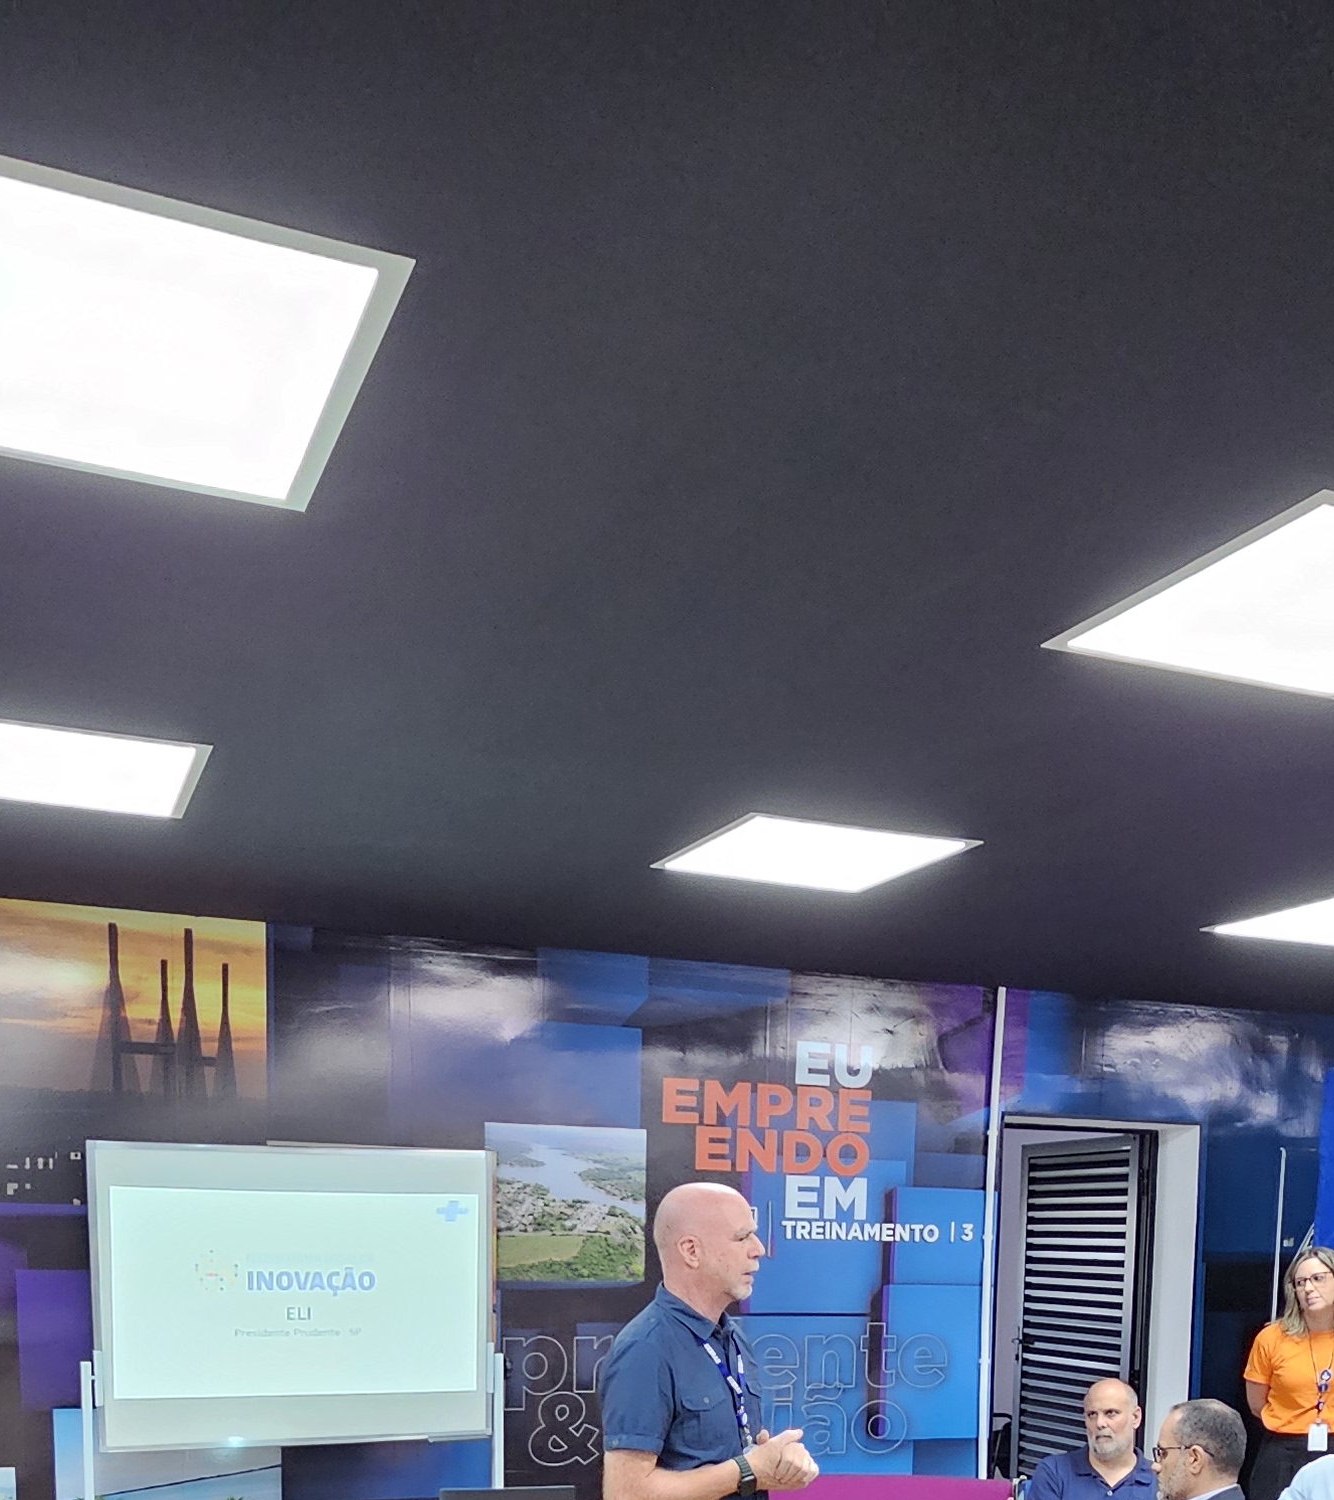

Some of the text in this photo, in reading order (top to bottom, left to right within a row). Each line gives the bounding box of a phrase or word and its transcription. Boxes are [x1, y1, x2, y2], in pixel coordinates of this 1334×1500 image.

[795, 1040, 874, 1089] EU
[661, 1076, 873, 1133] EMPRE
[694, 1125, 871, 1177] ENDO
[784, 1174, 868, 1221] EM
[781, 1220, 940, 1243] TREINAMENTO
[960, 1223, 974, 1242] 3
[247, 1267, 377, 1297] INOVAÇÃO
[286, 1307, 312, 1321] ELI
[503, 1321, 948, 1411] prente
[528, 1391, 601, 1466] &
